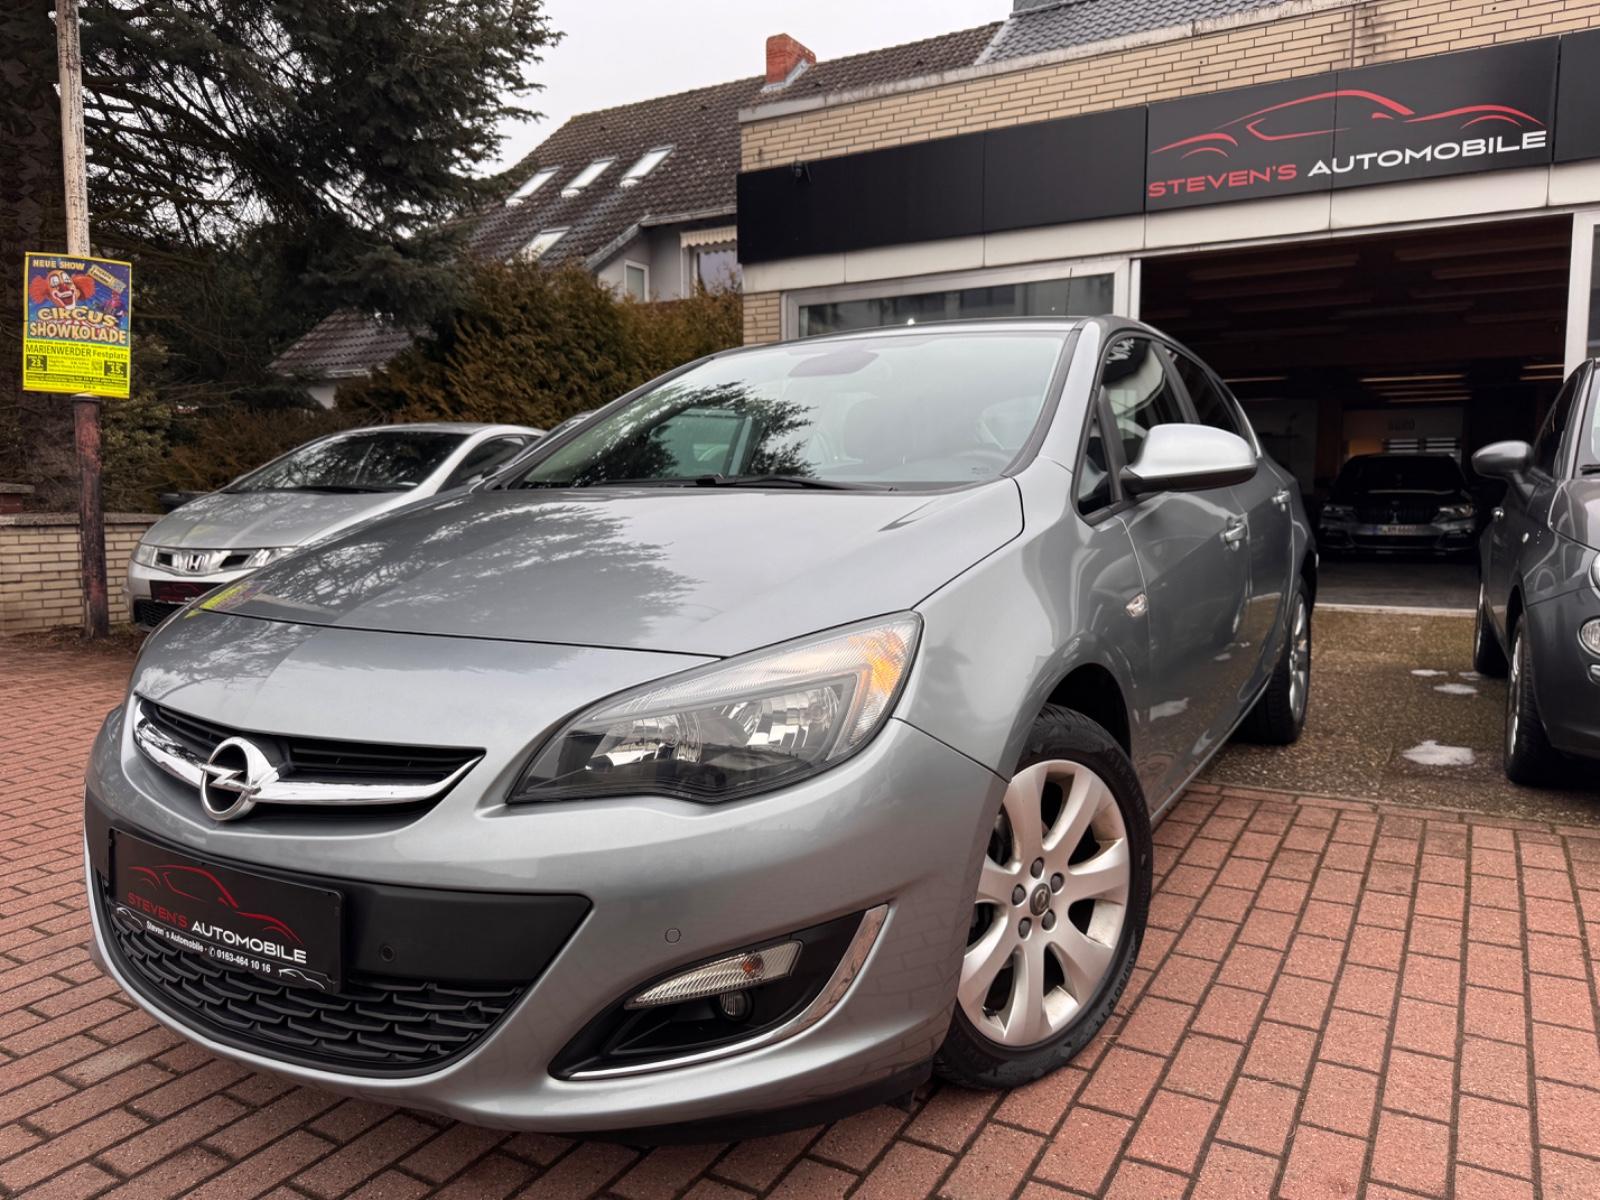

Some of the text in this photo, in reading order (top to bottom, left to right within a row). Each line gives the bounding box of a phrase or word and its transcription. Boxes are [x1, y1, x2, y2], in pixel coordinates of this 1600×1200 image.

[1148, 130, 1547, 197] STEVEN'S AUTOMOBILE
[33, 259, 86, 271] NEUE SHOW
[29, 321, 127, 344] SHOWKOLADE
[25, 344, 91, 357] MARIENWERDER
[92, 349, 128, 360] Festplatz
[127, 892, 307, 964] STEVEN'S AUTOMOBILE
[170, 932, 204, 952] Automobile
[217, 949, 249, 967] 0163-464
[250, 959, 260, 970] 10
[261, 962, 271, 973] 16
